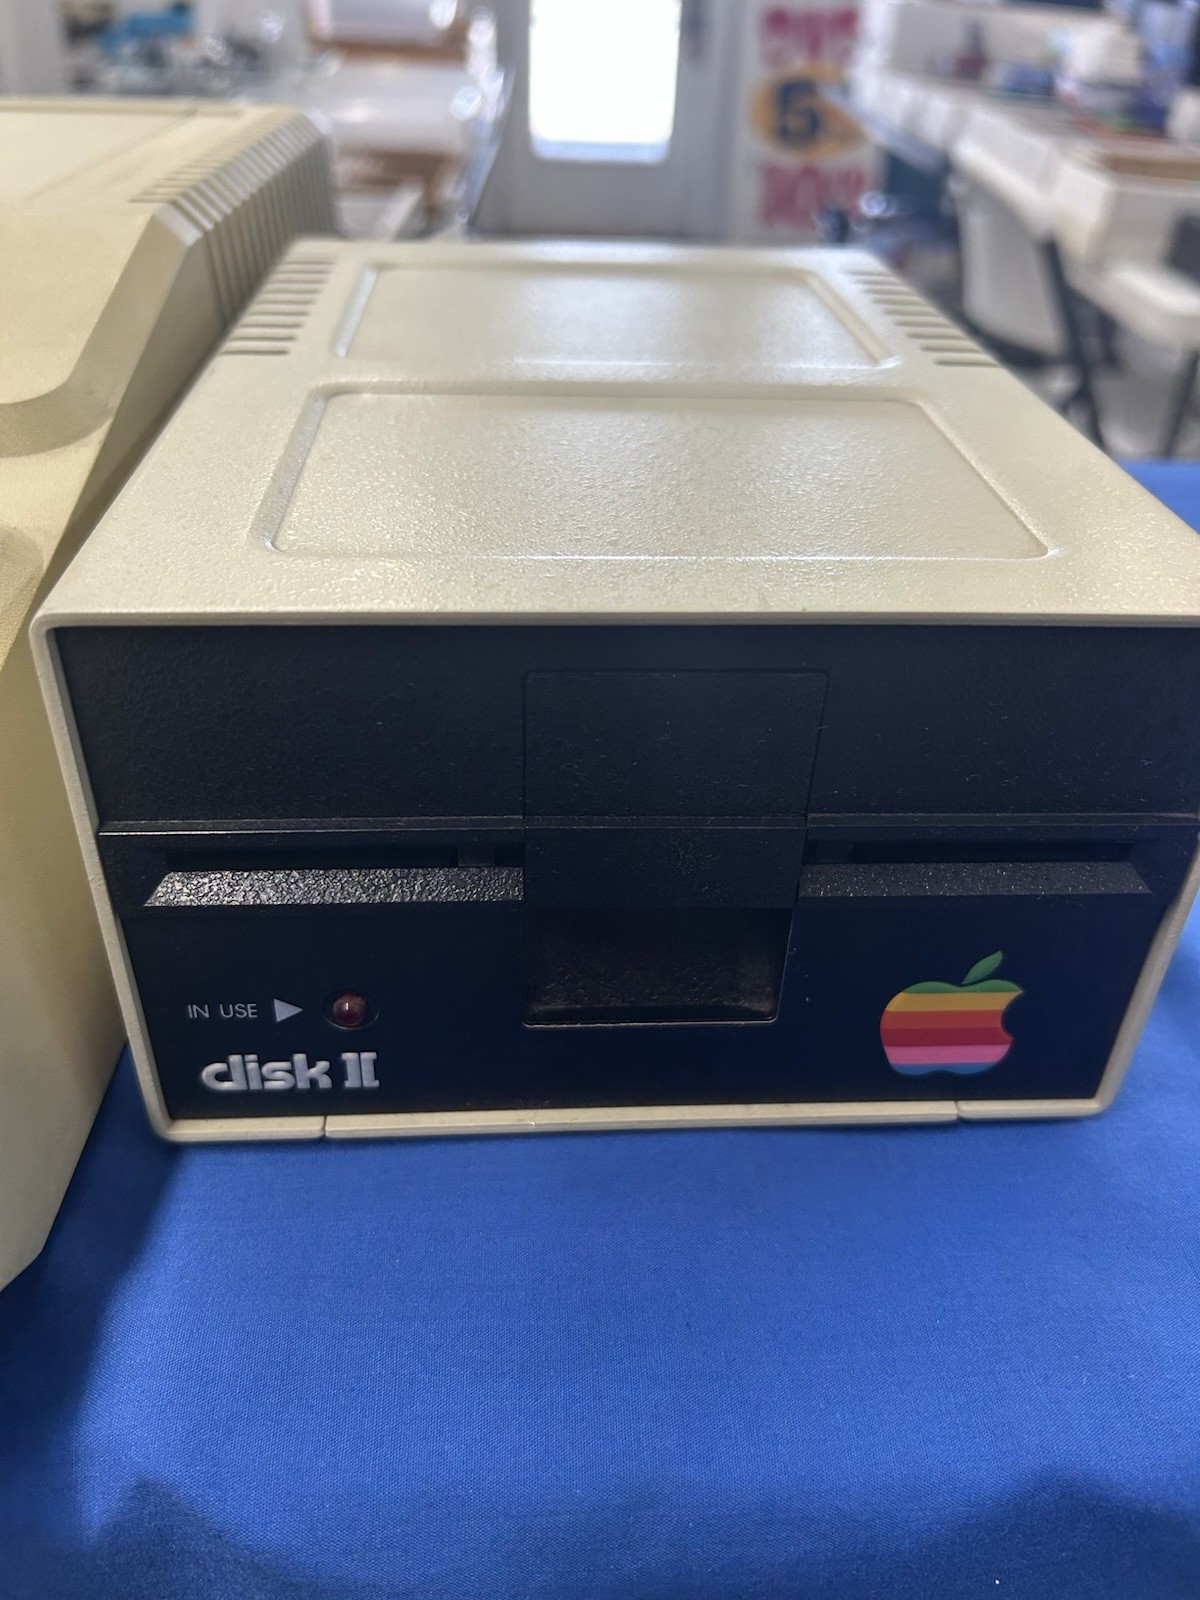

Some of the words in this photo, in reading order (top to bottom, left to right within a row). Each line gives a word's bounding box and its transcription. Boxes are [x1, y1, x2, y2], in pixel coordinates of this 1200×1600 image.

[187, 1004, 210, 1019] IN
[220, 1003, 258, 1019] USE
[201, 1053, 332, 1091] disk
[341, 1051, 380, 1088] II
